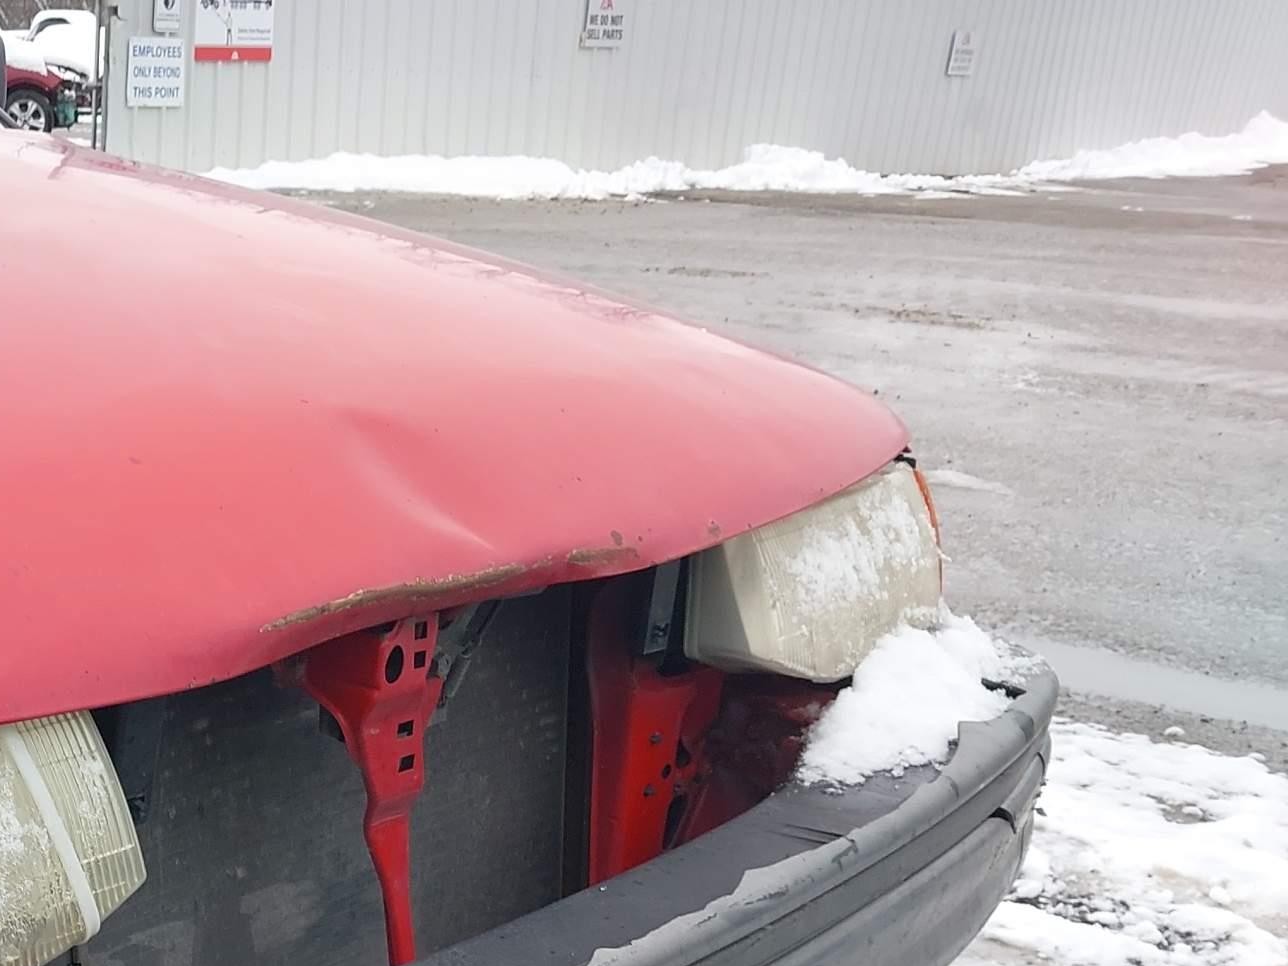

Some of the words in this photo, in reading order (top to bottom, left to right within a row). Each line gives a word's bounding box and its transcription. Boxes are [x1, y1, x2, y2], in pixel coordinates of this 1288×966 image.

[589, 14, 599, 25] WE
[600, 14, 609, 26] DO
[610, 14, 623, 26] NOT
[587, 28, 600, 40] SELL
[601, 28, 623, 40] PARTS
[132, 45, 182, 58] EMPLOYEES
[133, 66, 152, 78] ONLY
[153, 66, 181, 78] BEYOND
[133, 86, 152, 98] THIS
[154, 86, 180, 98] POINT
